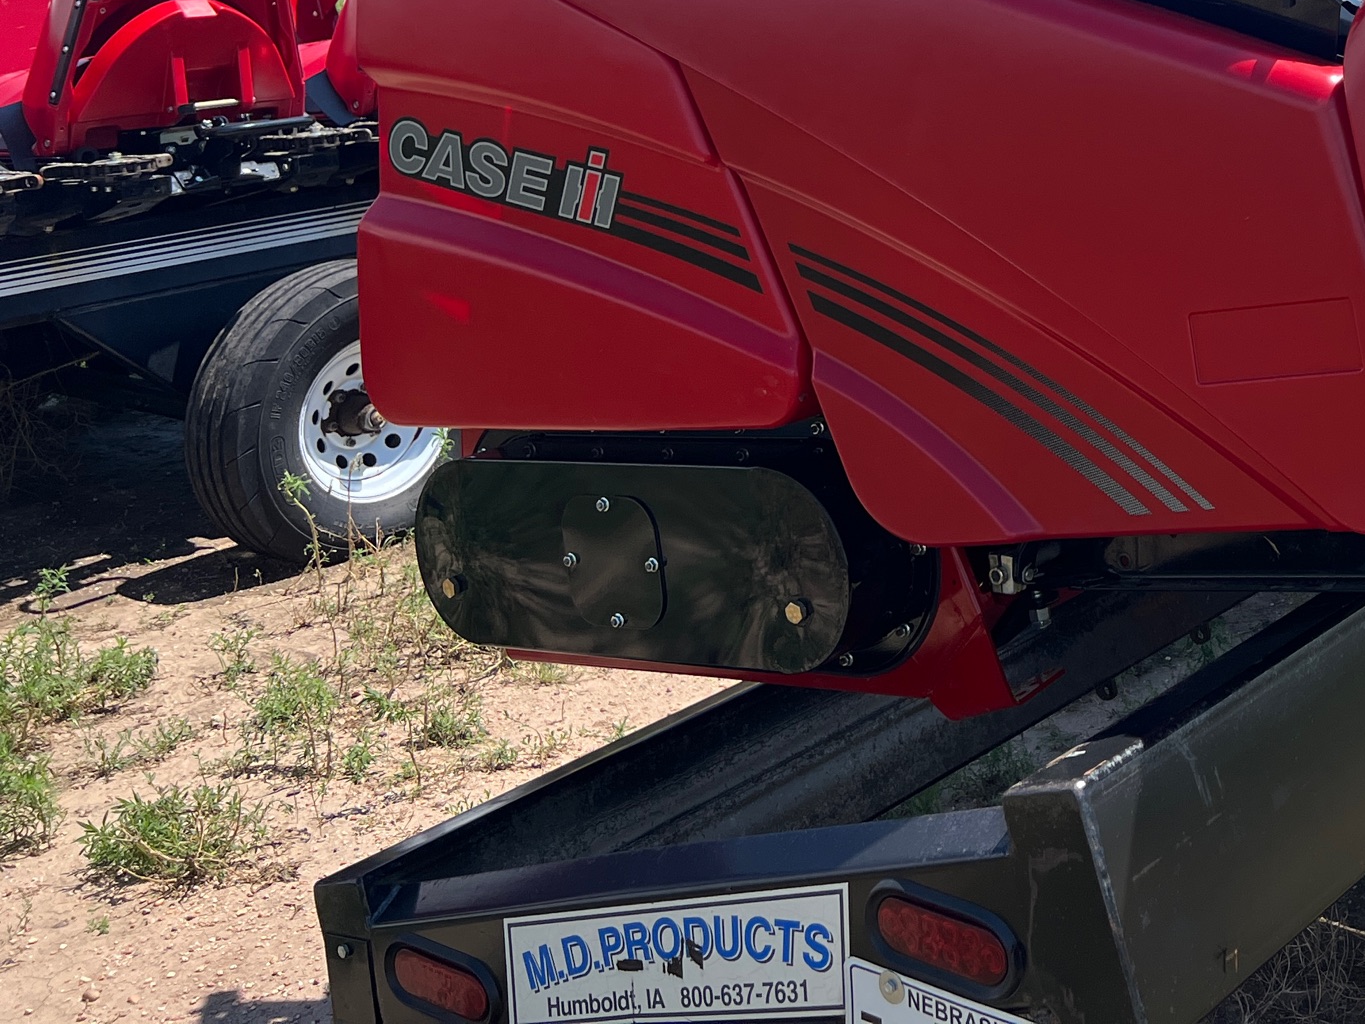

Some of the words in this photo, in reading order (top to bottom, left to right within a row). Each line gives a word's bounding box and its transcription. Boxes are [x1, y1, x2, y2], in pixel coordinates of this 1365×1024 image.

[389, 119, 554, 211] CASE
[547, 989, 642, 1017] Humboldt,
[647, 988, 666, 1009] IA
[680, 979, 809, 1008] 800-637-7631
[908, 989, 1000, 1024] NEBRA
